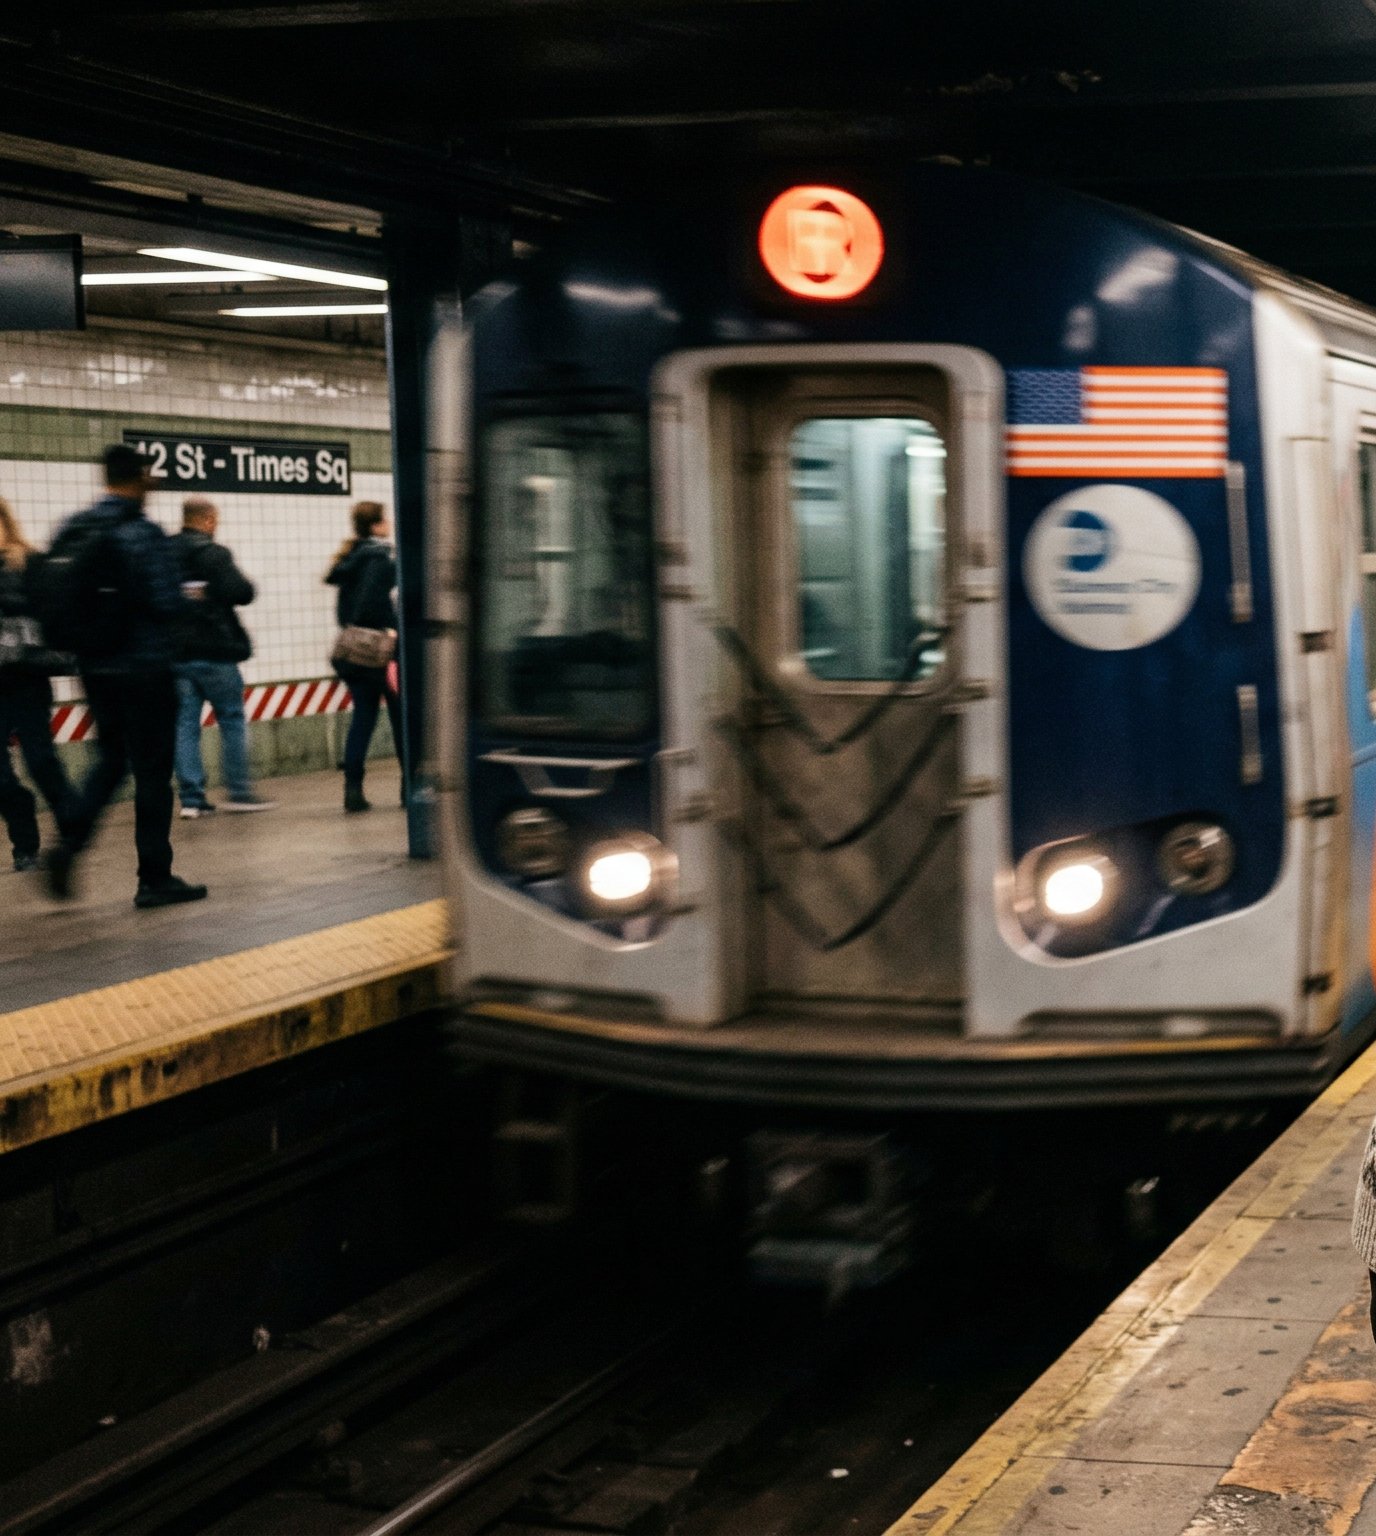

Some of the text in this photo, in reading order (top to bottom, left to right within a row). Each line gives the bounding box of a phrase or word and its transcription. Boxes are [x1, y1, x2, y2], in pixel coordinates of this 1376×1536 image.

[175, 443, 207, 480] St
[230, 446, 309, 483] Times
[315, 449, 349, 491] Sq
